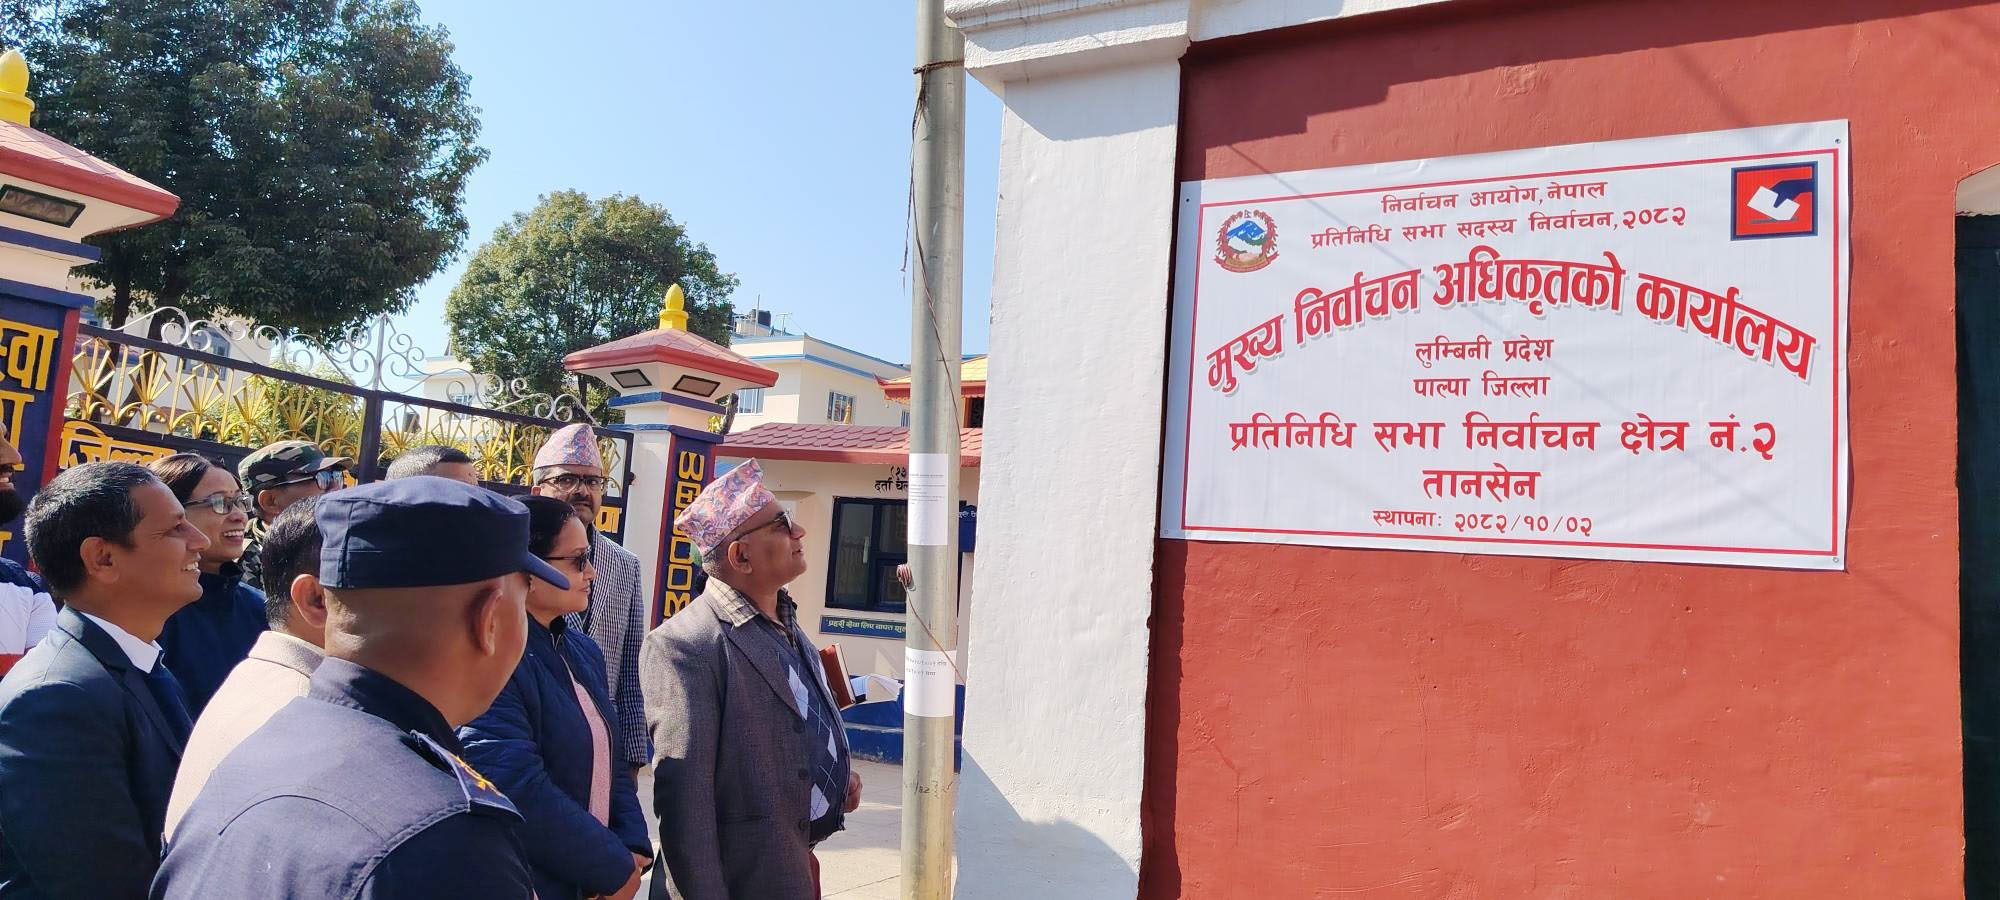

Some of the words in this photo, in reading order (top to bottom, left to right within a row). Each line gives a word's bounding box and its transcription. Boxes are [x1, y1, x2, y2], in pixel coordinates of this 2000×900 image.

[1381, 193, 1458, 213] निर्वाचन
[1311, 222, 1392, 249] प्रतिनिधि
[1402, 223, 1447, 241] सभा
[1457, 218, 1517, 238] सदस्य
[1206, 314, 1284, 393] मुख्य
[1294, 269, 1423, 345] निर्वाचन
[1433, 245, 1627, 317] अधिकृतको
[1635, 273, 1818, 382] कार्यालय
[1415, 335, 1492, 369] लुम्बिनी
[1503, 334, 1554, 362] प्रदेश
[1413, 378, 1471, 398] पाल्पा
[1481, 370, 1552, 398] जिल्ला
[1229, 412, 1358, 452] प्रतिनिधि
[1374, 422, 1446, 452] सभा
[1462, 411, 1601, 452] निर्वाचन
[1620, 412, 1690, 454] क्षेत्र
[1422, 462, 1541, 502] तानसेन
[1455, 513, 1593, 537] २०८२/१०/०२
